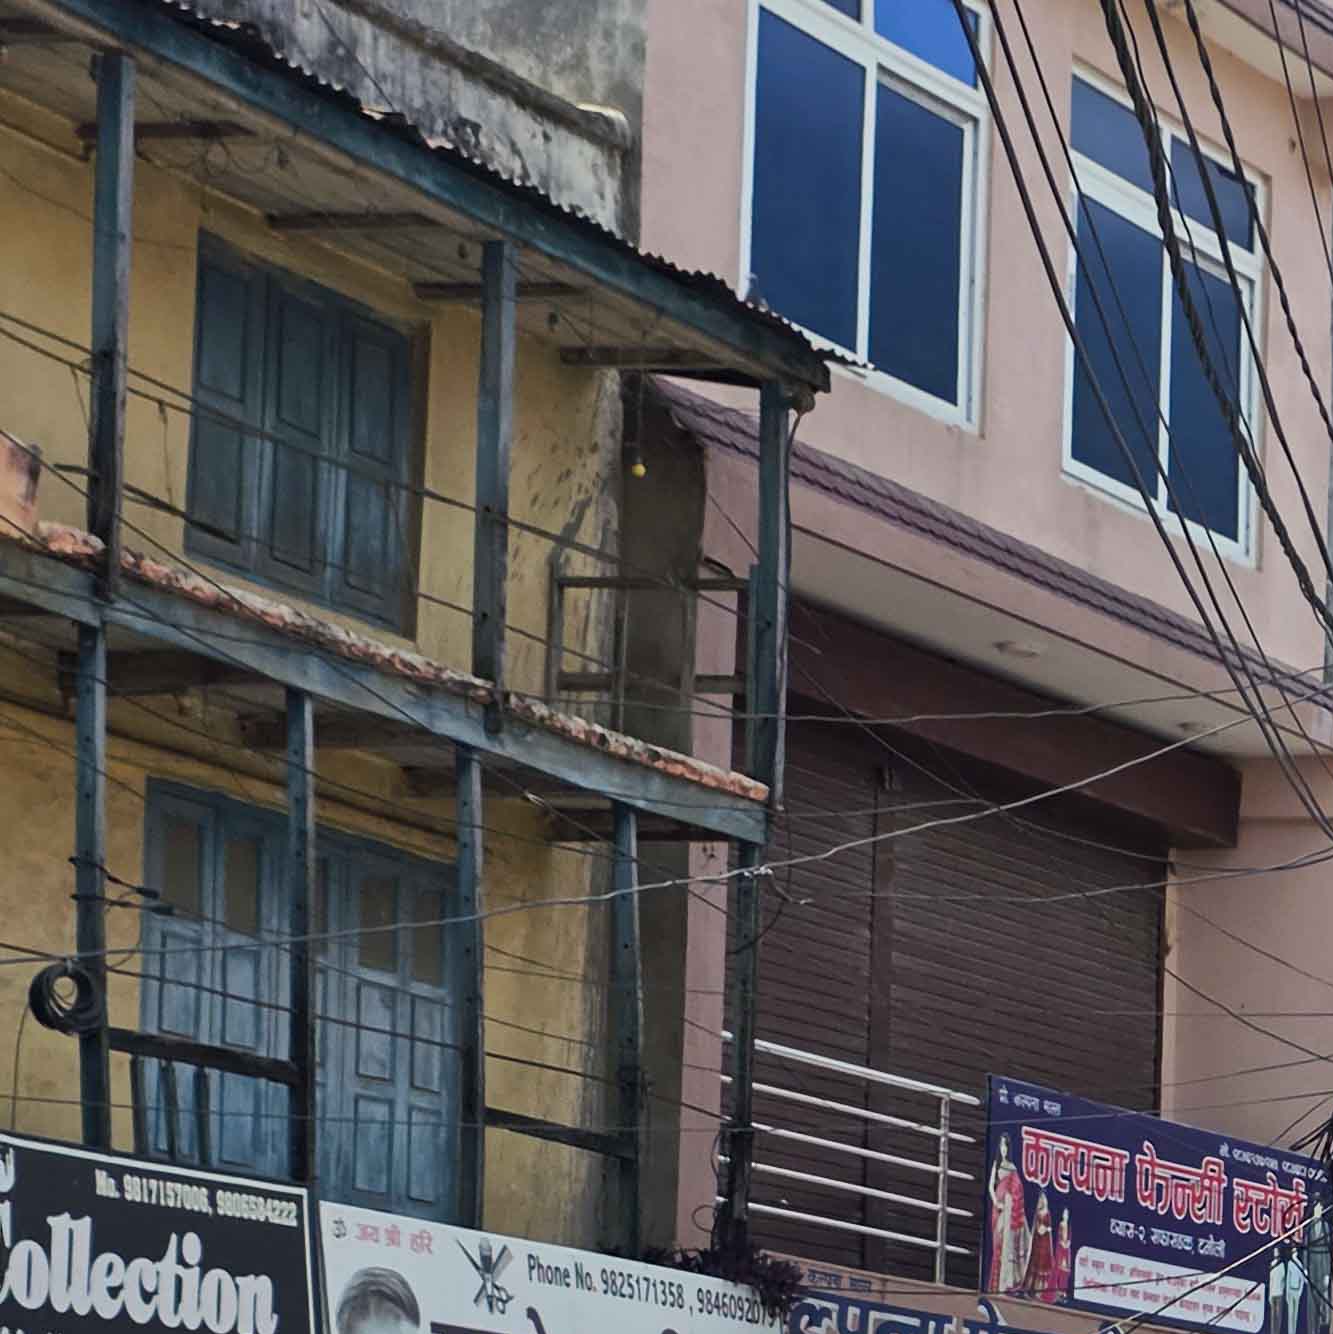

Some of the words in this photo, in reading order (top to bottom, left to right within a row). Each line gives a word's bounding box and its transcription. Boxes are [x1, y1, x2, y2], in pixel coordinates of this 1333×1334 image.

[1021, 1126, 1129, 1203] कल्पना
[1136, 1140, 1226, 1226] फेन्सी
[527, 1253, 572, 1287] Phone
[574, 1262, 598, 1293] No.
[600, 1267, 686, 1309] 9825171358
